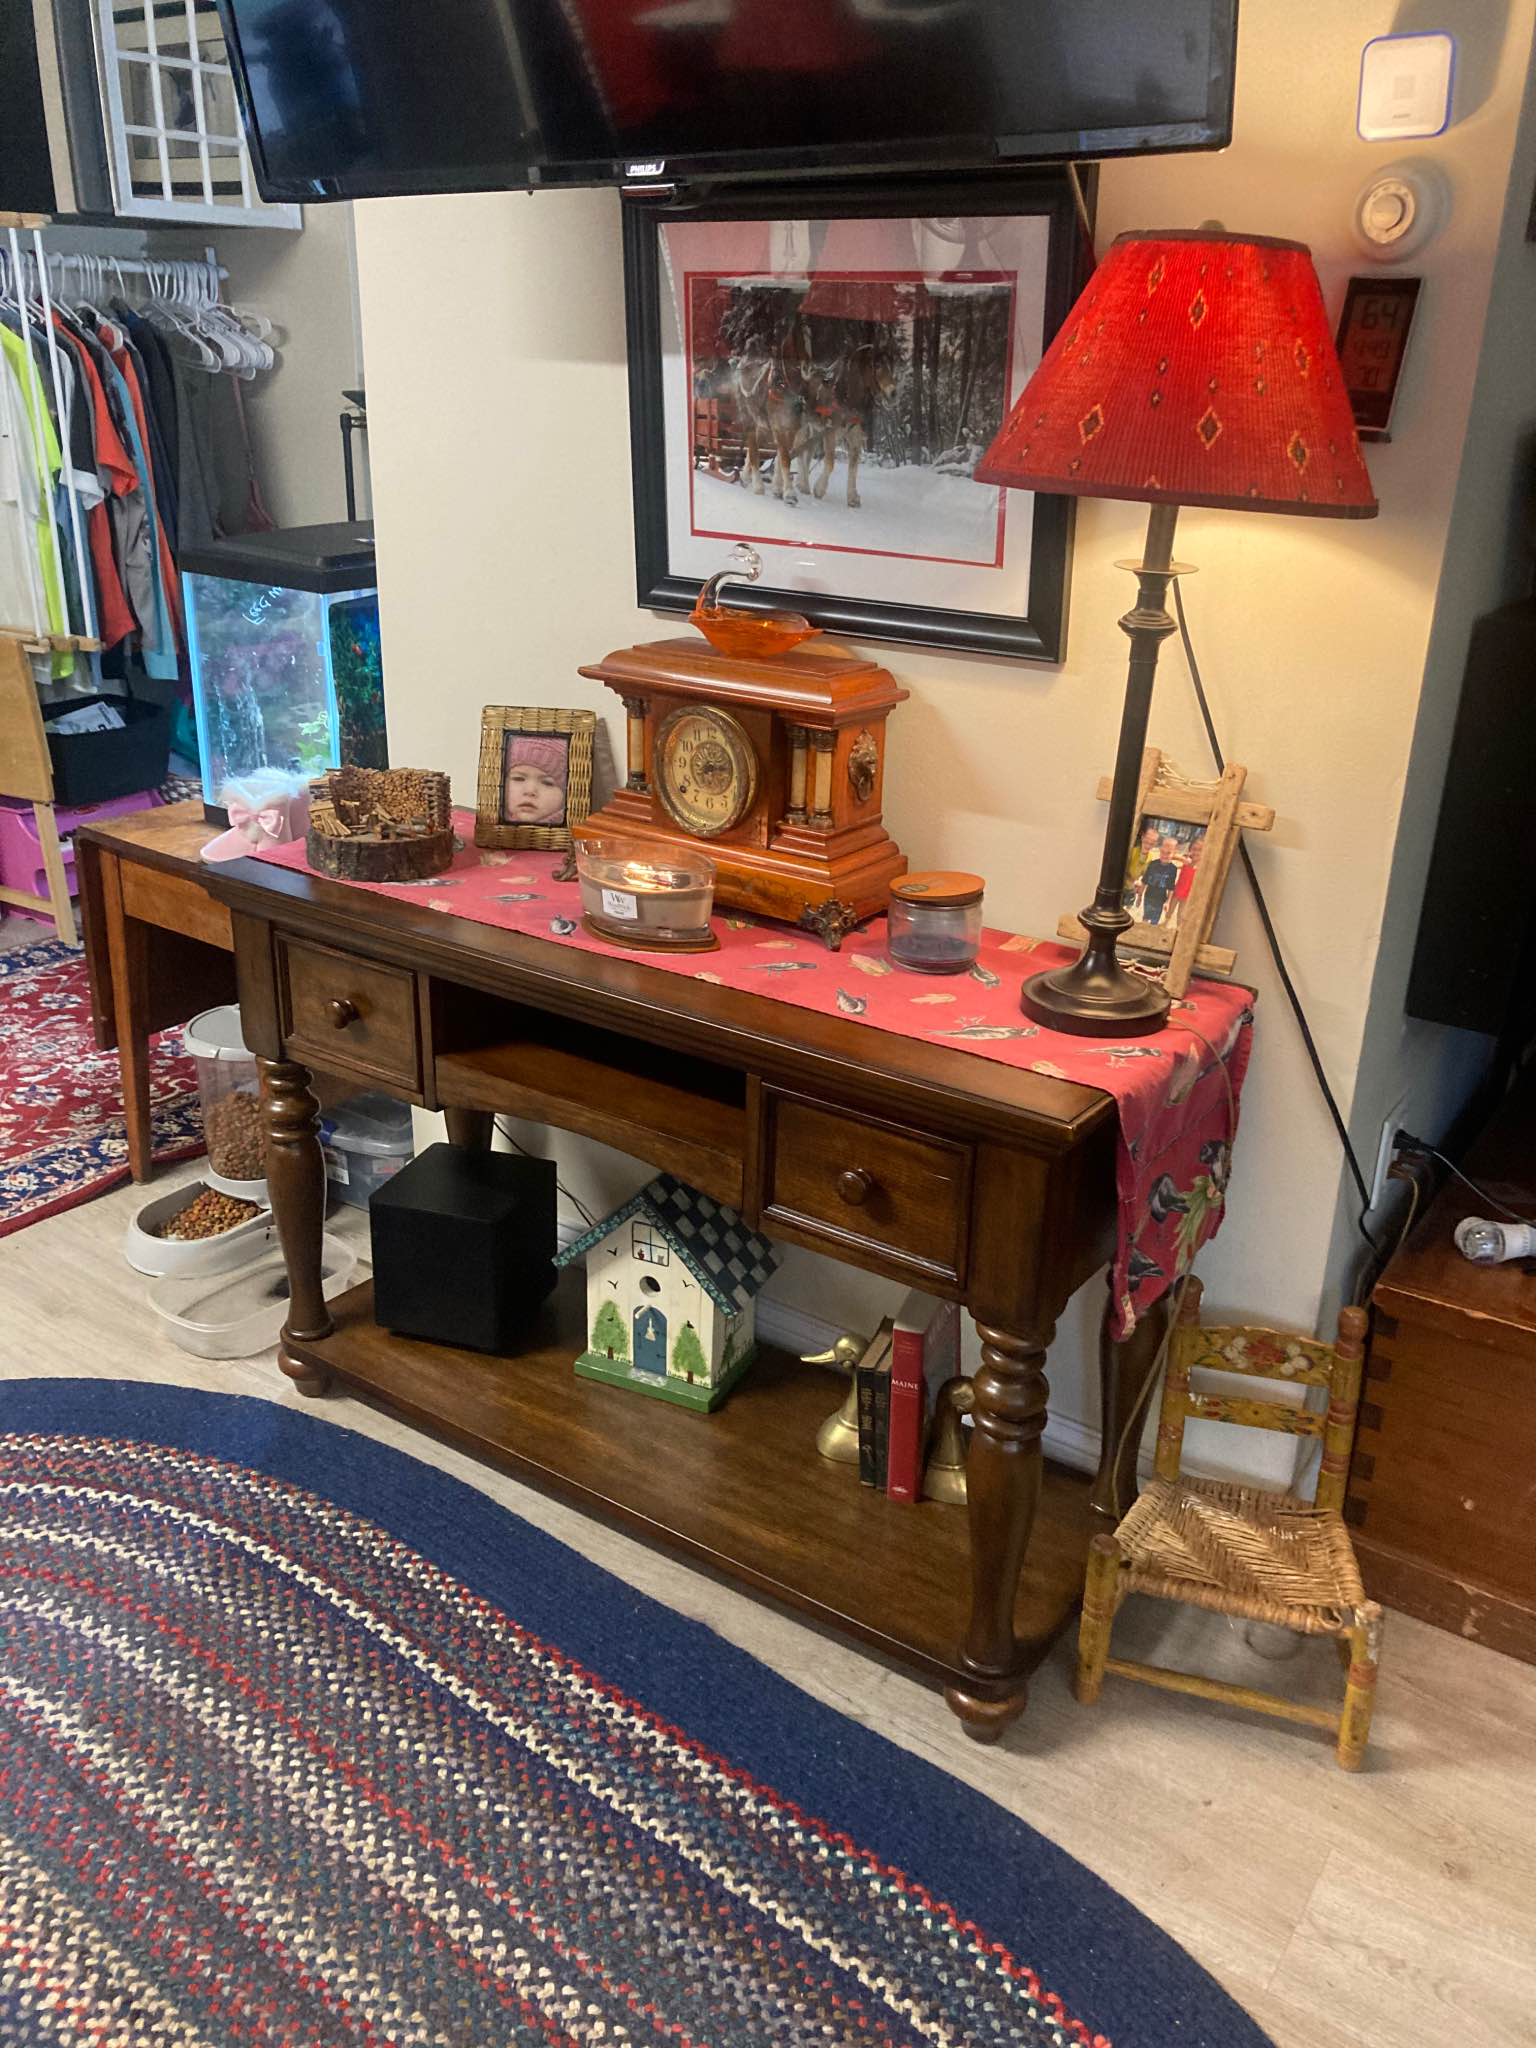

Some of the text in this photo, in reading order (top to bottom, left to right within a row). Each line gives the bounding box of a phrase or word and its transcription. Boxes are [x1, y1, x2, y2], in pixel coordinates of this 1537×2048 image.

[630, 164, 657, 174] PHILIPS
[1361, 299, 1398, 330] 64
[891, 1378, 919, 1391] MAINE
